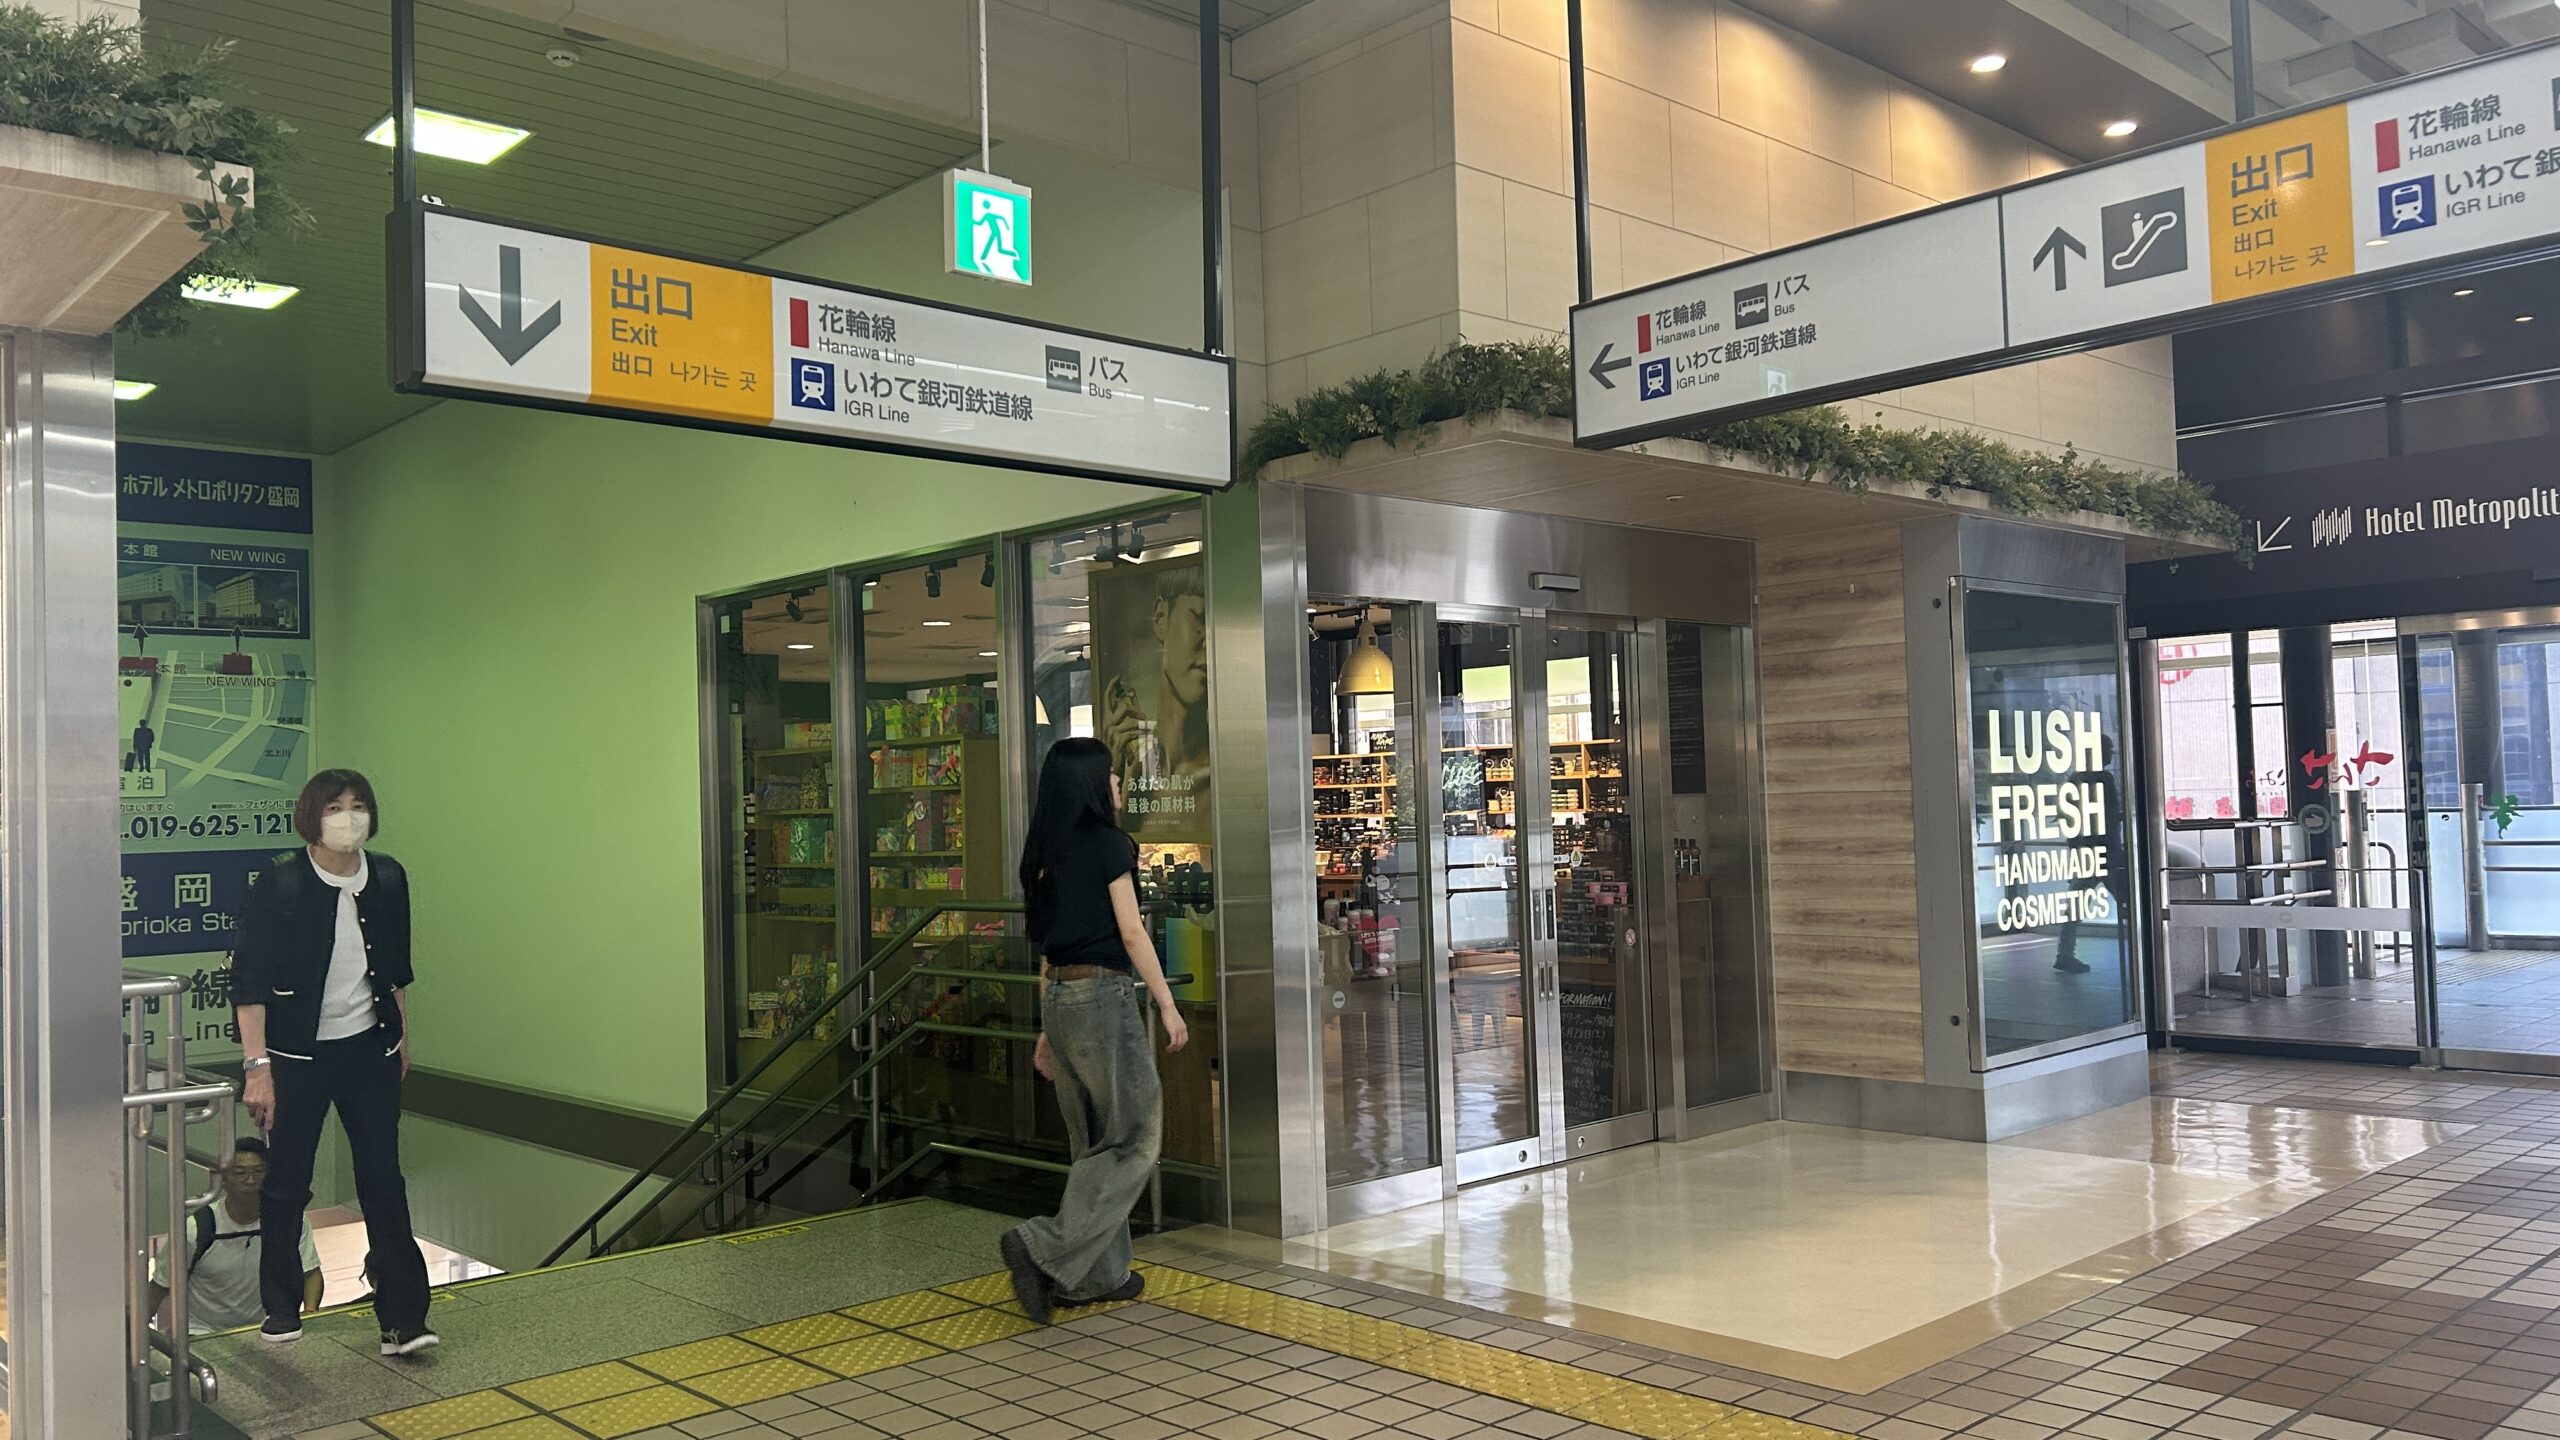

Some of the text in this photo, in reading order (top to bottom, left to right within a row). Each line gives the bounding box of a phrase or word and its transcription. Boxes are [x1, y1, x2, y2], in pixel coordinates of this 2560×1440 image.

[2409, 94, 2501, 140] 花輪線
[2409, 121, 2526, 160] Hanawa Line
[2231, 142, 2315, 198] 出口
[2445, 146, 2560, 196] いわて銀
[2232, 198, 2278, 227] Exit
[2446, 189, 2526, 218] IGR Line
[2234, 228, 2274, 253] 出口
[2235, 245, 2329, 280] 나가는 곳
[611, 268, 693, 321] 出口
[1774, 274, 1810, 299] バス
[818, 303, 897, 343] 花輪線
[1655, 300, 1707, 331] 花輪線
[1774, 303, 1795, 317] Bus
[611, 317, 658, 348] Exit
[1656, 320, 1720, 347] Hanawa Line
[818, 336, 915, 367] Hanawa Line
[1676, 323, 1817, 373] いわて銀河鉄道線
[612, 351, 653, 377] 出口
[670, 361, 758, 393] 나가는 곳
[1089, 356, 1128, 384] バス
[844, 368, 1033, 421] いわて銀河鉄道線
[1089, 382, 1113, 400] Bus
[1676, 371, 1720, 390] IGR Line
[844, 400, 910, 423] IGR Line
[122, 473, 300, 509] ホテル メトロポリタン盛岡
[2365, 487, 2560, 537] Hotel Metropolit
[123, 543, 159, 558] 本館
[210, 548, 286, 564] NEW WING
[156, 663, 187, 675] 本館
[206, 676, 276, 688] NEW WING
[1988, 709, 2103, 774] LUSH
[1127, 774, 1195, 792] あなたの肌が
[1127, 795, 1196, 814] 最後の原材料
[1990, 782, 2106, 843] FRESH
[1994, 845, 2108, 888] HANDMADE
[1997, 887, 2110, 932] COSMETICS
[122, 915, 192, 936] orioka
[1560, 991, 1613, 1008] FORMATION!!
